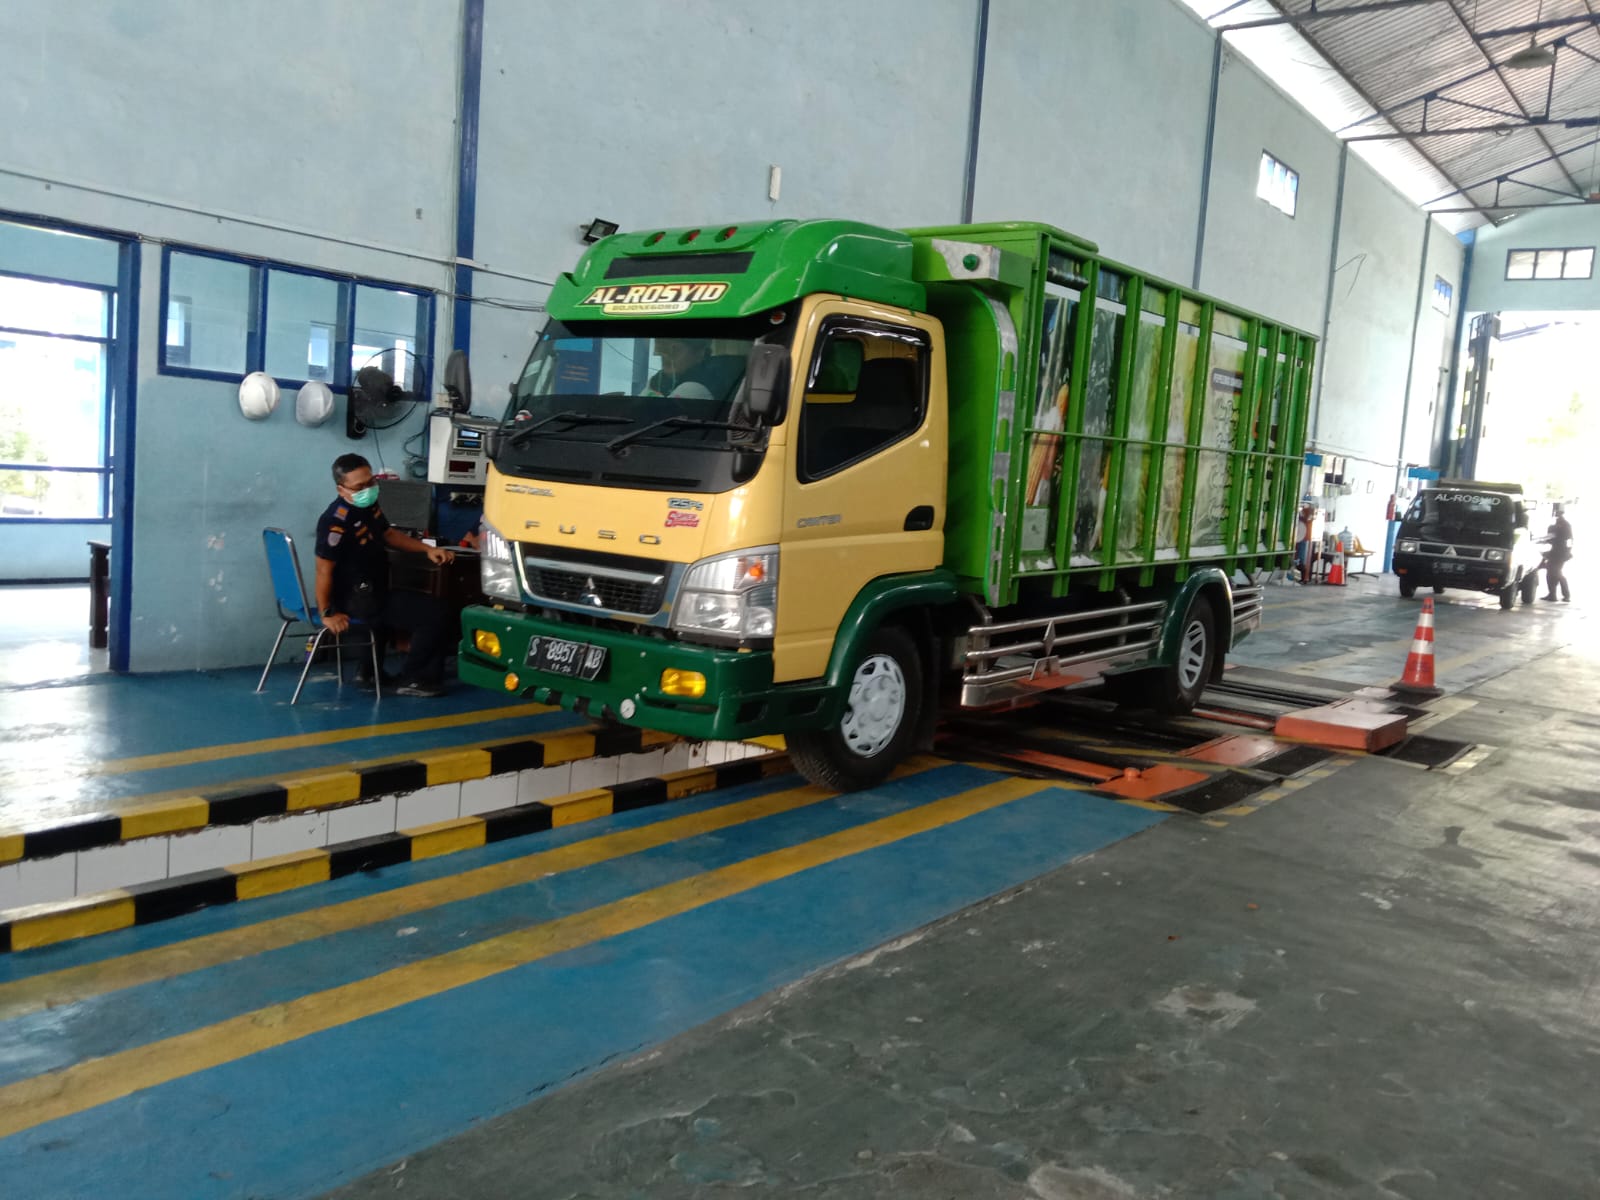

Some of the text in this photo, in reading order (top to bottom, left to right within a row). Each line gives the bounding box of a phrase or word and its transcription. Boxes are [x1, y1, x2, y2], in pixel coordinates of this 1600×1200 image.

[584, 284, 727, 304] AL-ROSYID
[525, 520, 661, 545] FUSO
[529, 638, 540, 656] S
